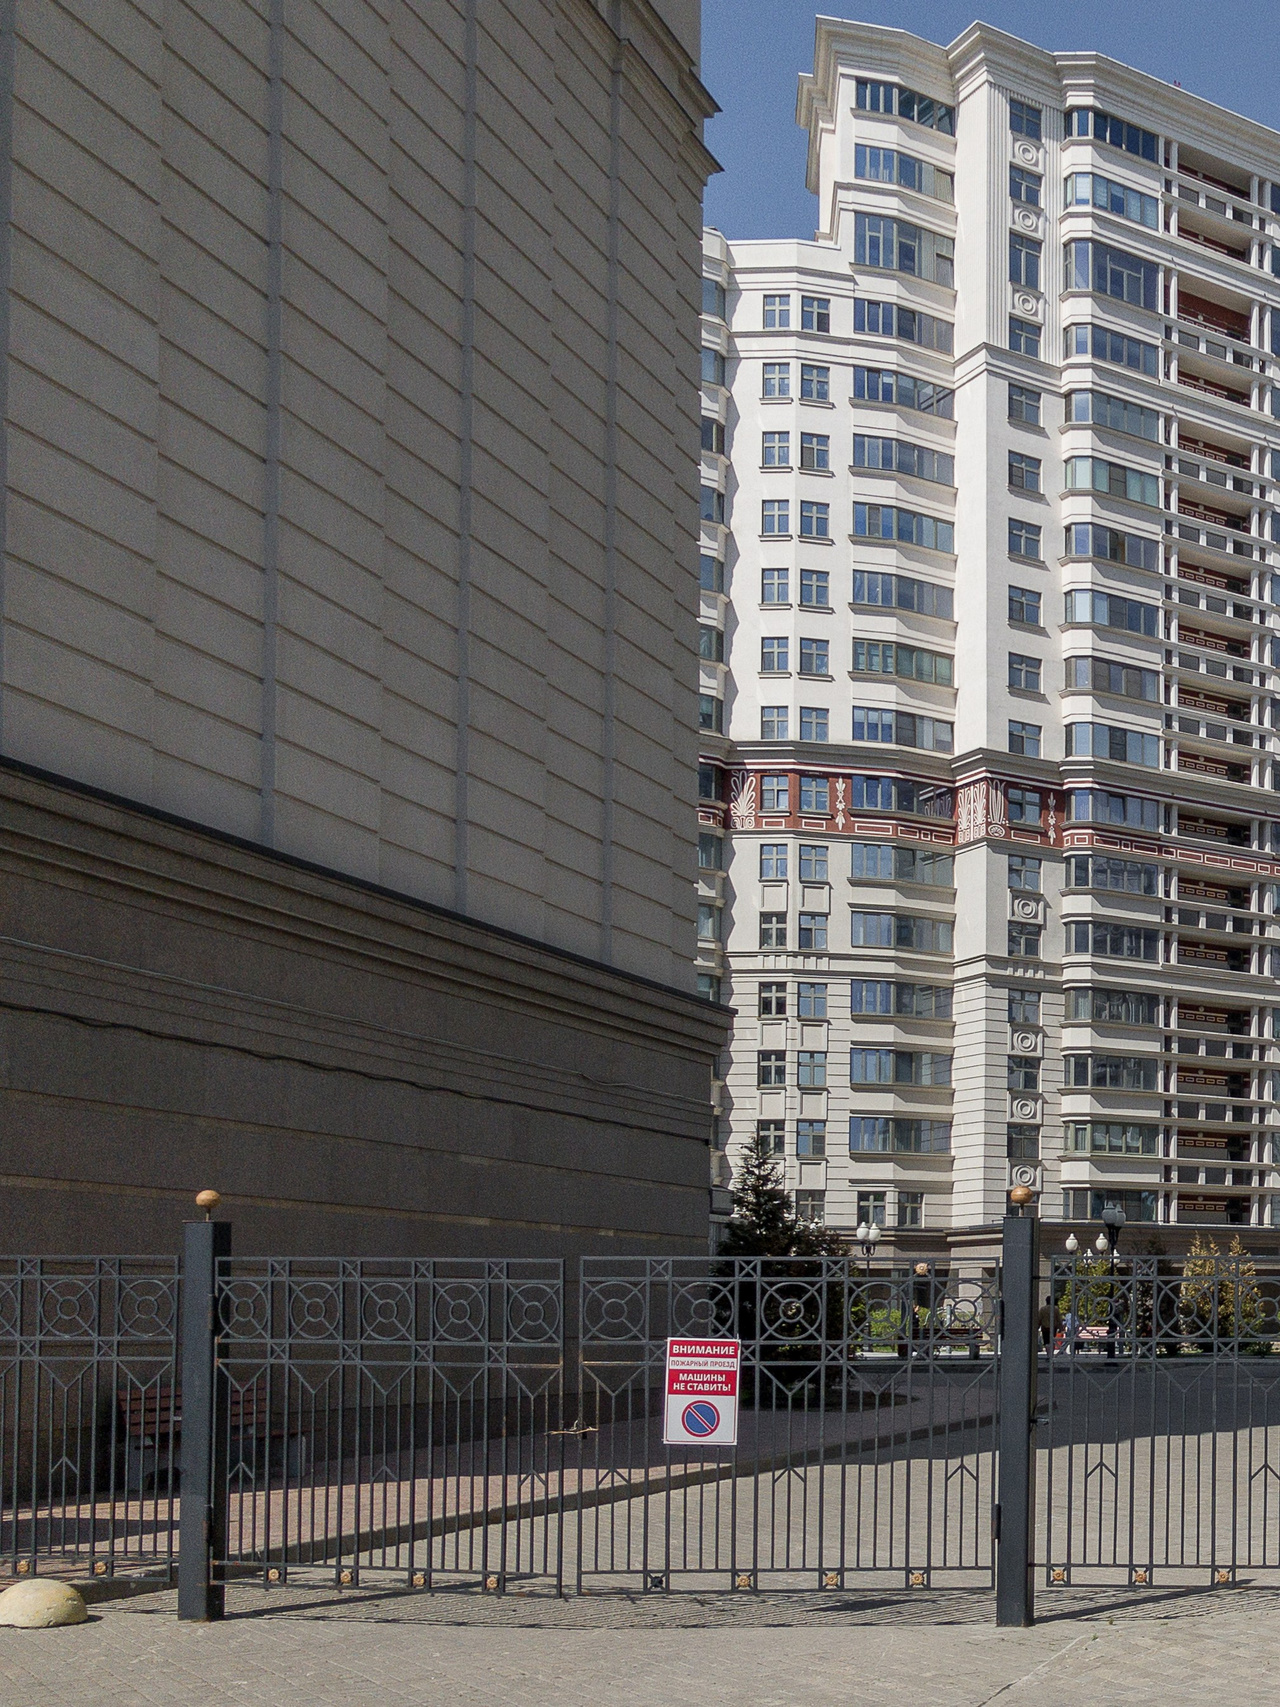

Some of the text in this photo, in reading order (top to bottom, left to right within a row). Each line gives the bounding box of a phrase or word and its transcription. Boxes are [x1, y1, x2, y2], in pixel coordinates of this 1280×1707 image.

[672, 1345, 735, 1355] ВНИМАНИЕ
[671, 1359, 735, 1368] ПОЖАРНЫЙ ПРОЕЗД
[679, 1373, 725, 1381] МАШИНЫ
[687, 1383, 731, 1391] СТАВИТЬ!
